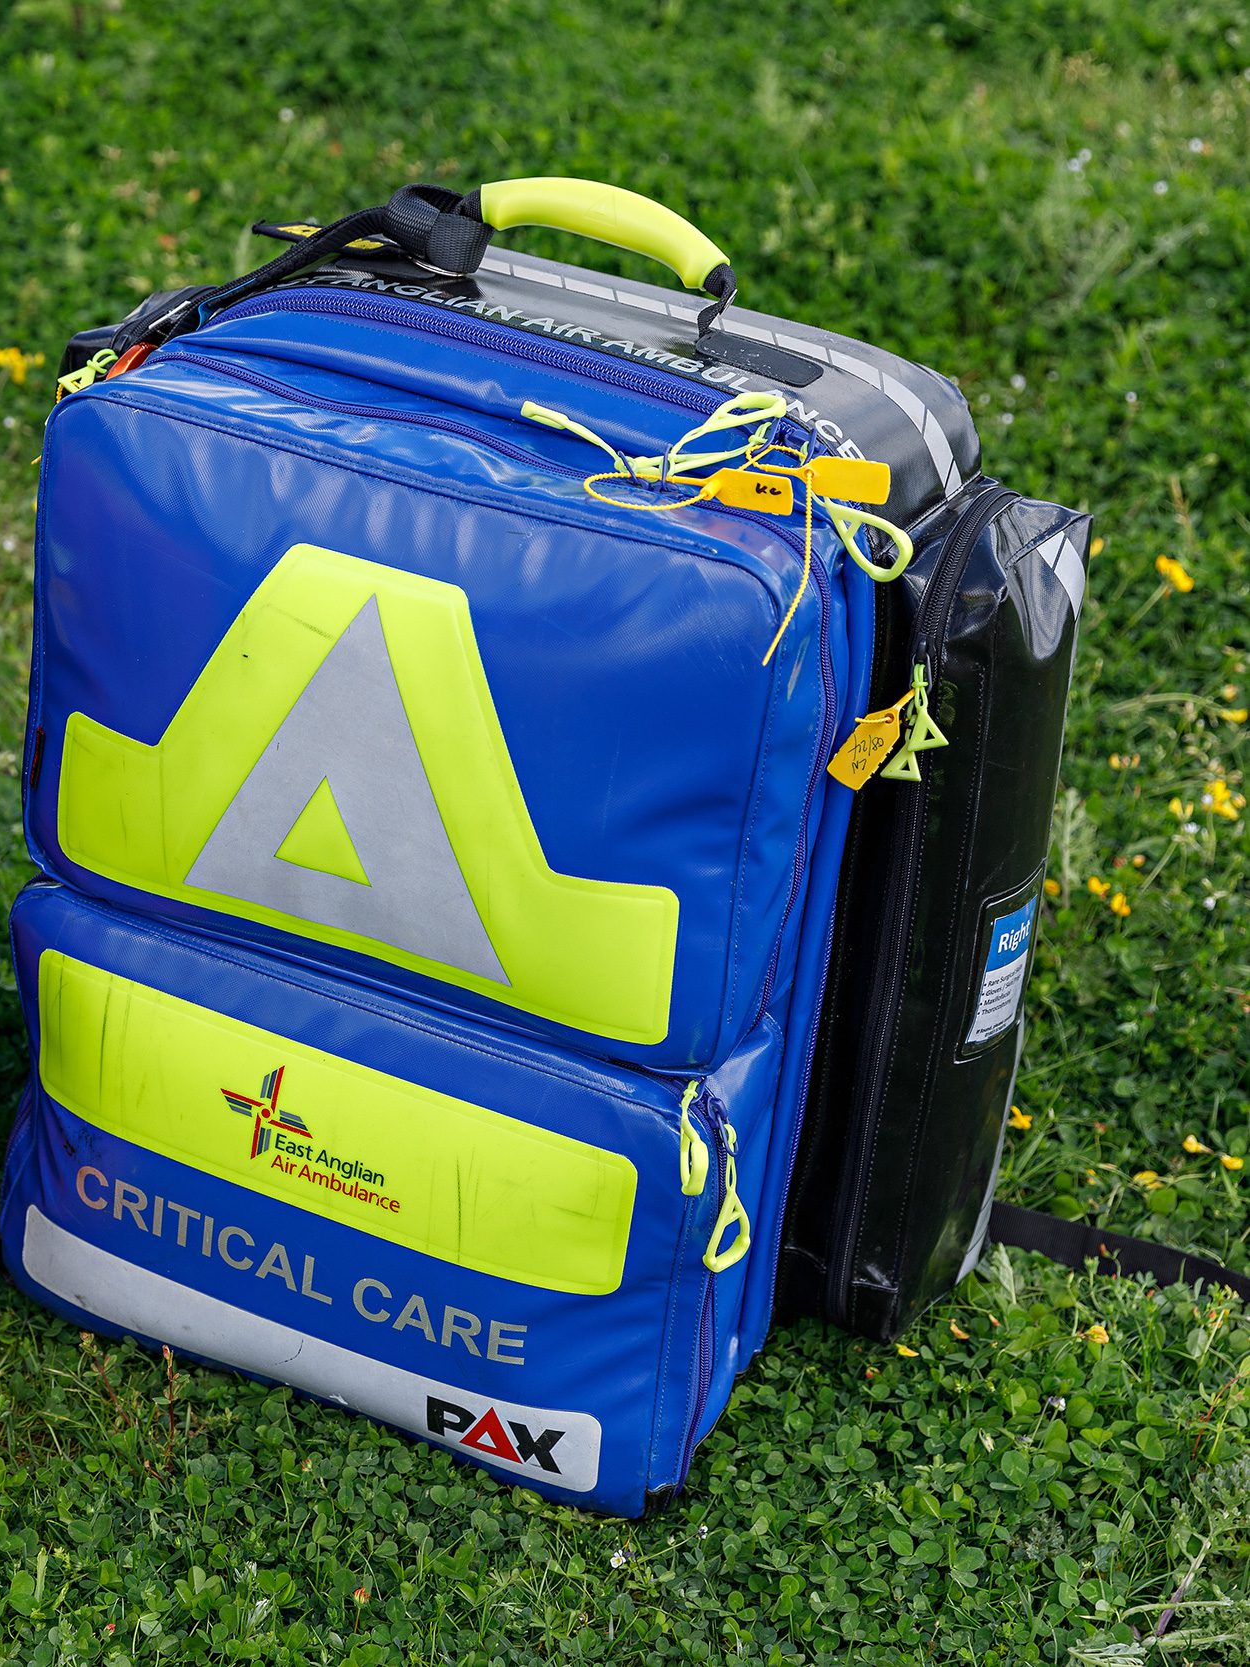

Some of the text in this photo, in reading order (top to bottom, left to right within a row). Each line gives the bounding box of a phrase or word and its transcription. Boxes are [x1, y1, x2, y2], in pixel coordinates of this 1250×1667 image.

[337, 275, 523, 322] ANGLIAN
[521, 317, 601, 343] AIR
[603, 339, 867, 460] AMBULNCE
[998, 920, 1030, 953] Right
[270, 1154, 401, 1214] Air Ambulance
[274, 1133, 385, 1188] East Anglian
[75, 1165, 528, 1366] CRITICAL CARE
[426, 1394, 567, 1476] PAX
